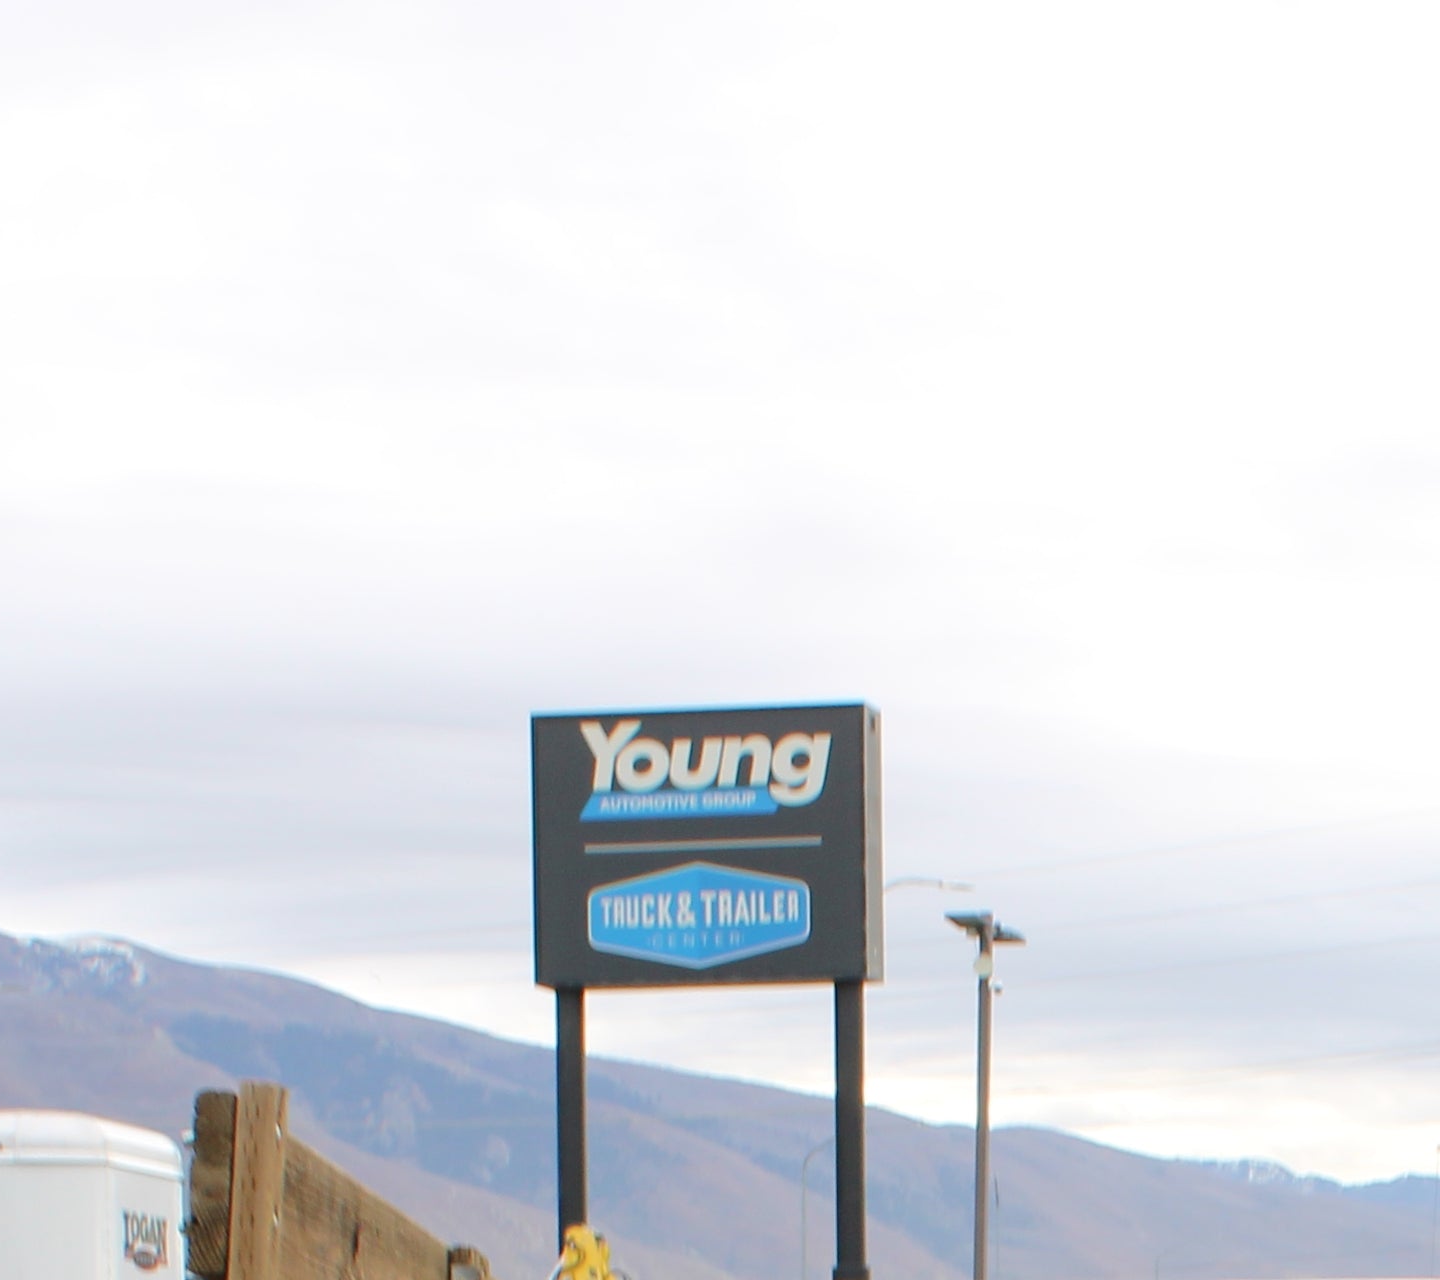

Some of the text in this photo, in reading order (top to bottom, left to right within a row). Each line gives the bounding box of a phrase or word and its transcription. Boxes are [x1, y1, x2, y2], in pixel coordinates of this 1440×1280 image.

[580, 719, 832, 807] Young
[600, 790, 757, 813] AUTOMOTIVE GROUP
[601, 893, 672, 929] TRUCK
[700, 889, 800, 928] TRAILER
[651, 930, 743, 949] CENTER
[121, 1209, 170, 1265] LOGAN
